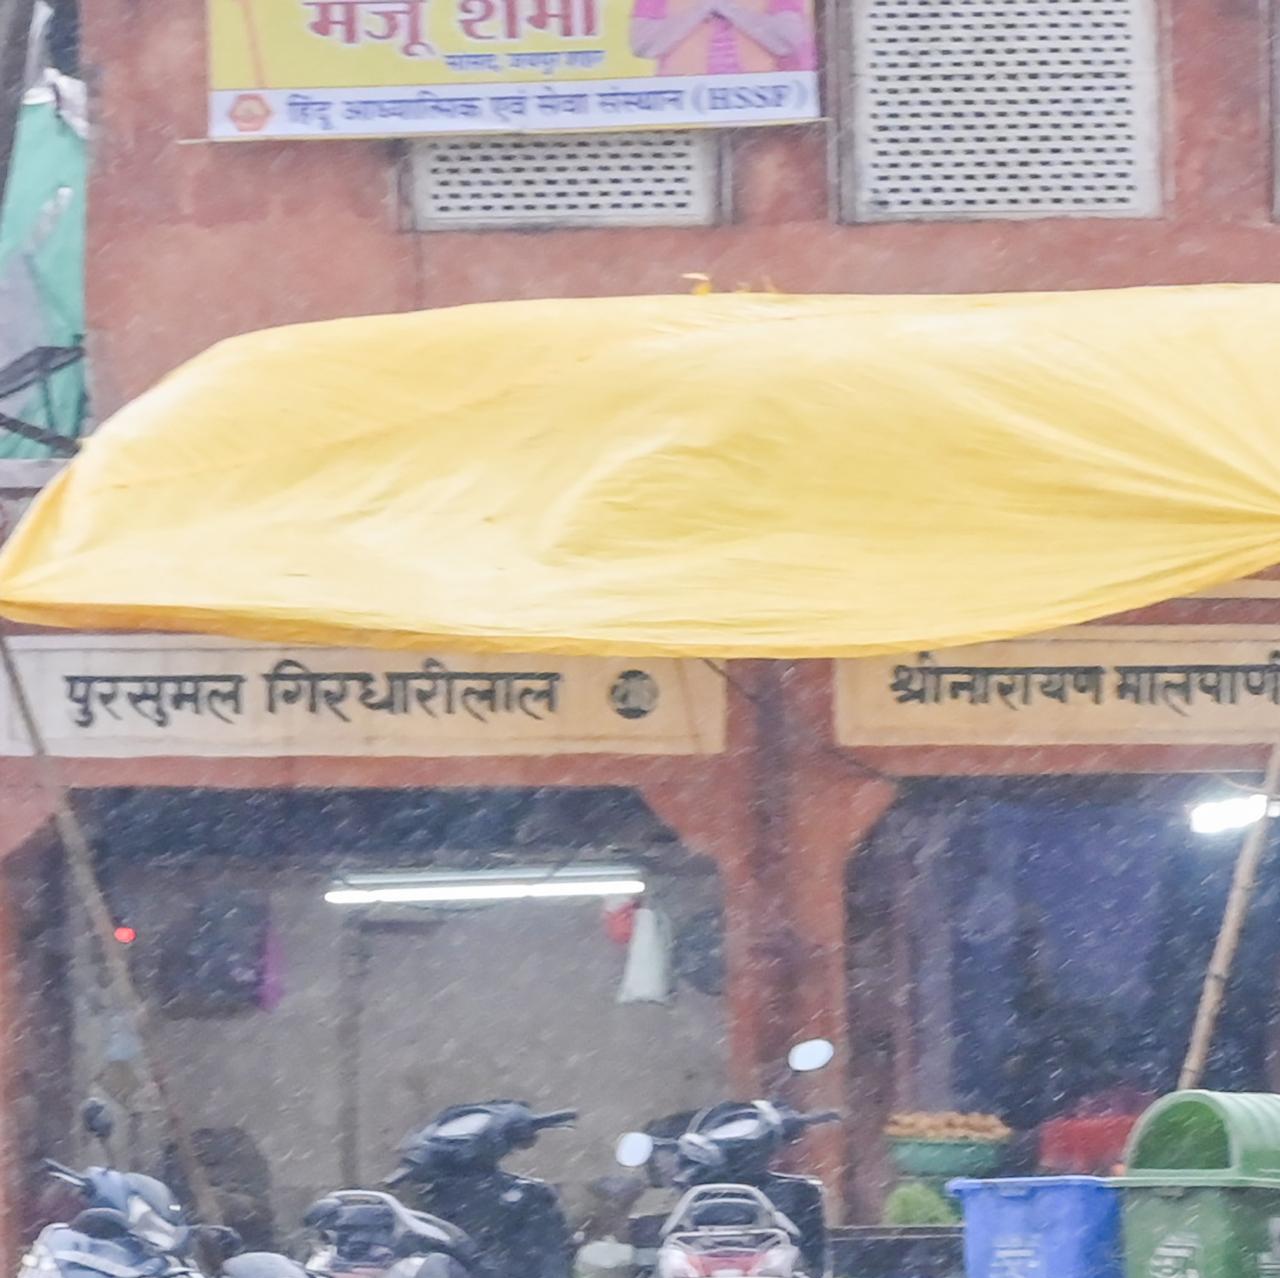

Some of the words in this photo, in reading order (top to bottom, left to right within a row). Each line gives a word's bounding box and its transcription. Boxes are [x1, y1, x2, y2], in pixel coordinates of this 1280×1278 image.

[536, 86, 588, 116] सेवा
[63, 673, 246, 728] पुरसुमल
[262, 657, 563, 722] गिरधारीलाल
